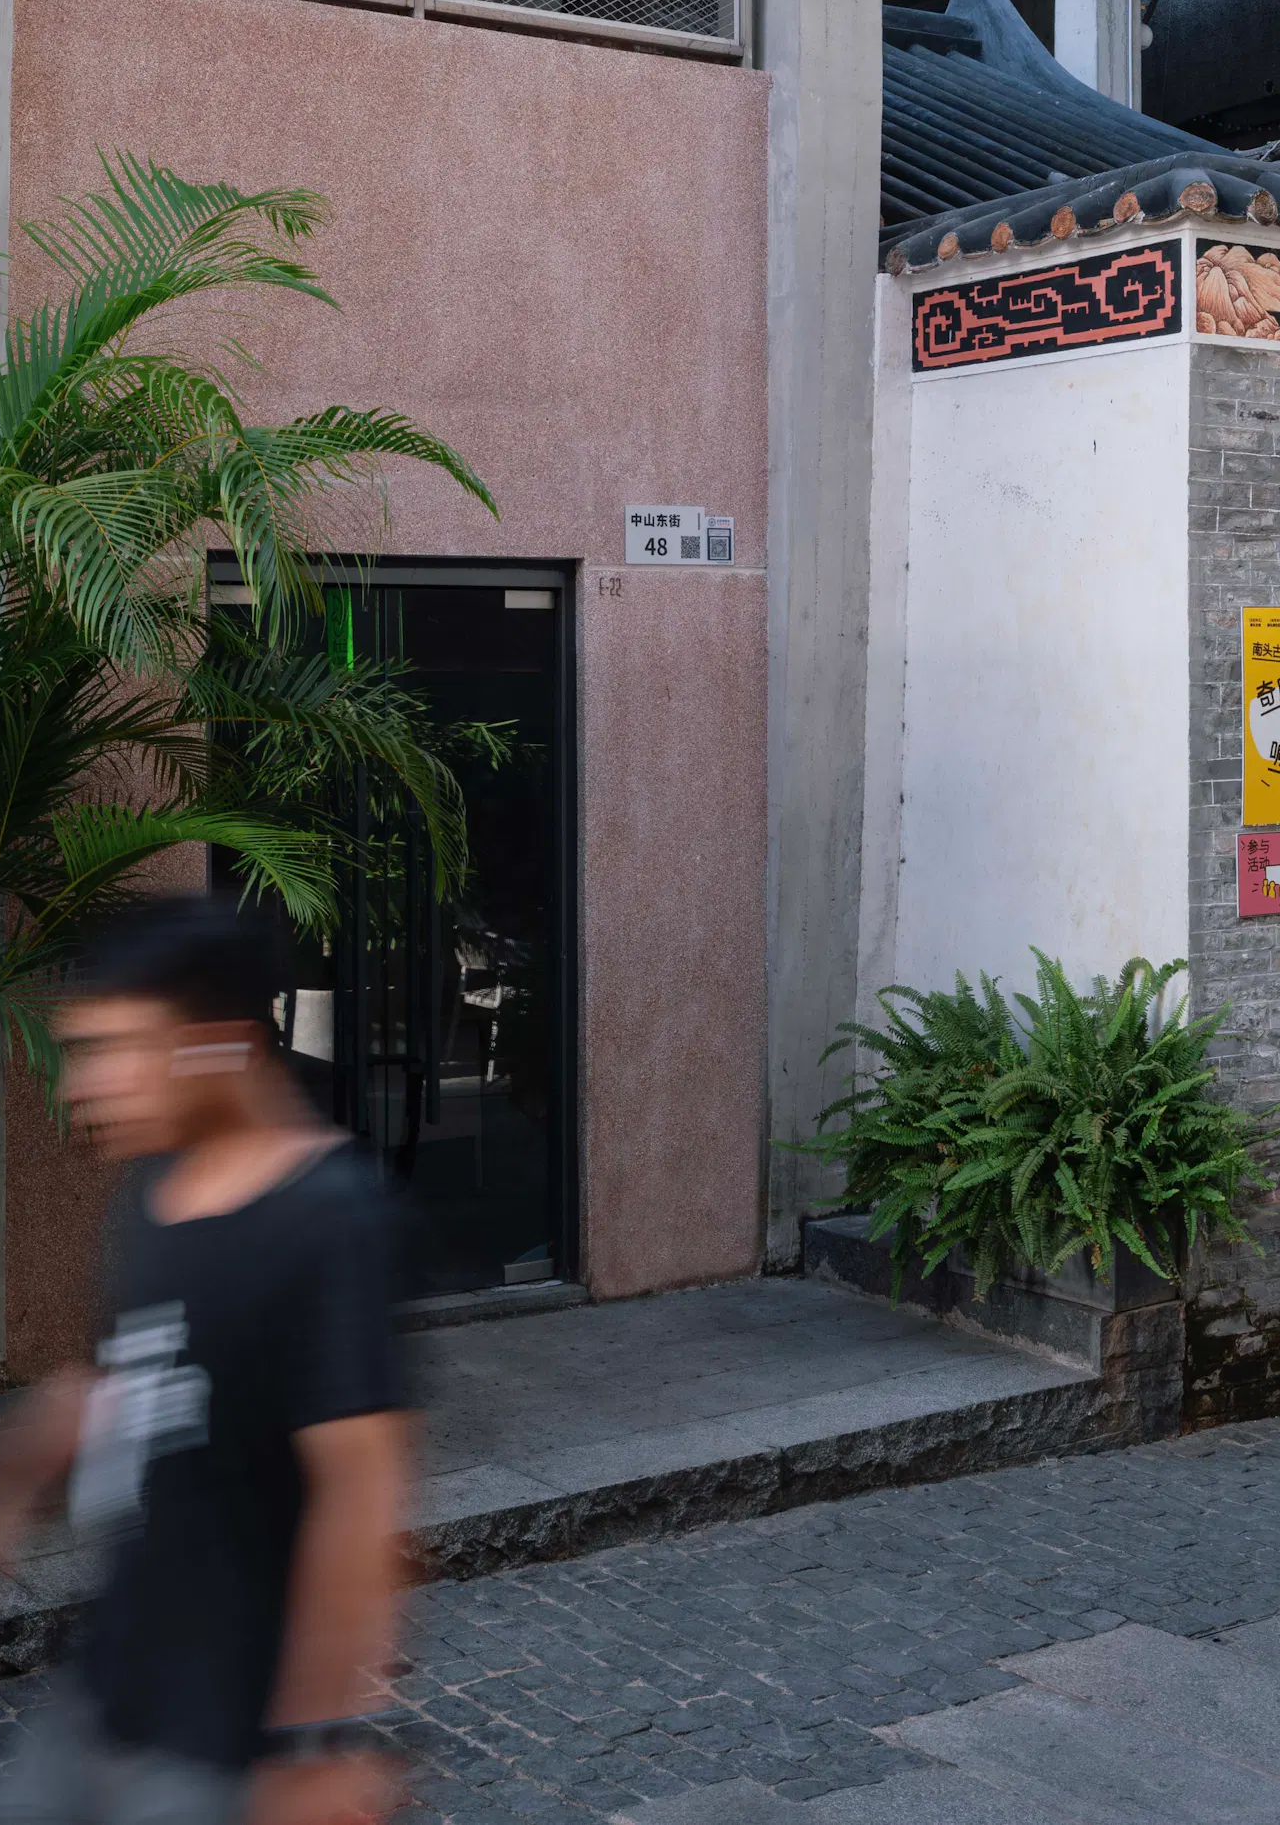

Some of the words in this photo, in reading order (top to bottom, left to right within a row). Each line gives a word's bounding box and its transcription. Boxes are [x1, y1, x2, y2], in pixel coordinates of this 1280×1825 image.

[631, 513, 681, 528] 中山东街
[644, 537, 668, 556] 48
[599, 577, 622, 597] E-22
[1247, 839, 1269, 855] 参与
[1247, 856, 1270, 872] 活动
